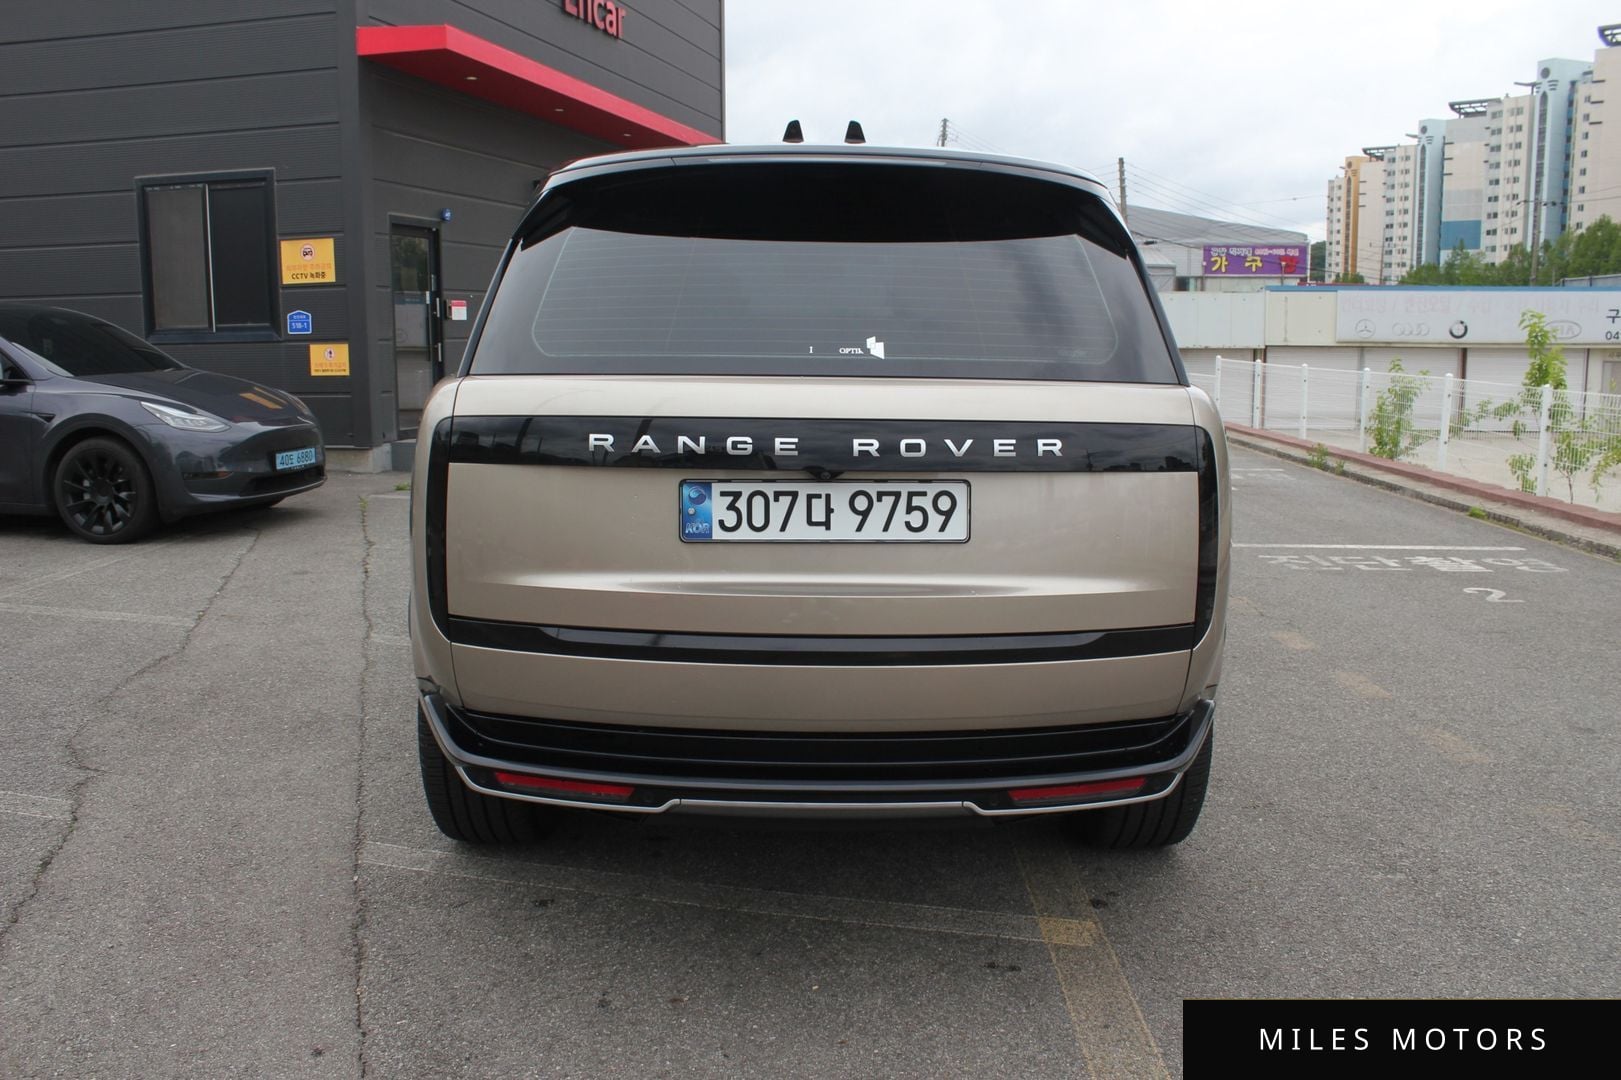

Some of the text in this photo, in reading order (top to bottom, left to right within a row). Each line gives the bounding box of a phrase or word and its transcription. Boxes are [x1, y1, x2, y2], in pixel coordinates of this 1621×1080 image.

[291, 272, 308, 280] CCTV
[588, 433, 1063, 457] RANGE ROVER
[718, 490, 958, 532] 307다 9759
[685, 522, 710, 534] KOR
[1463, 587, 1527, 603] 2
